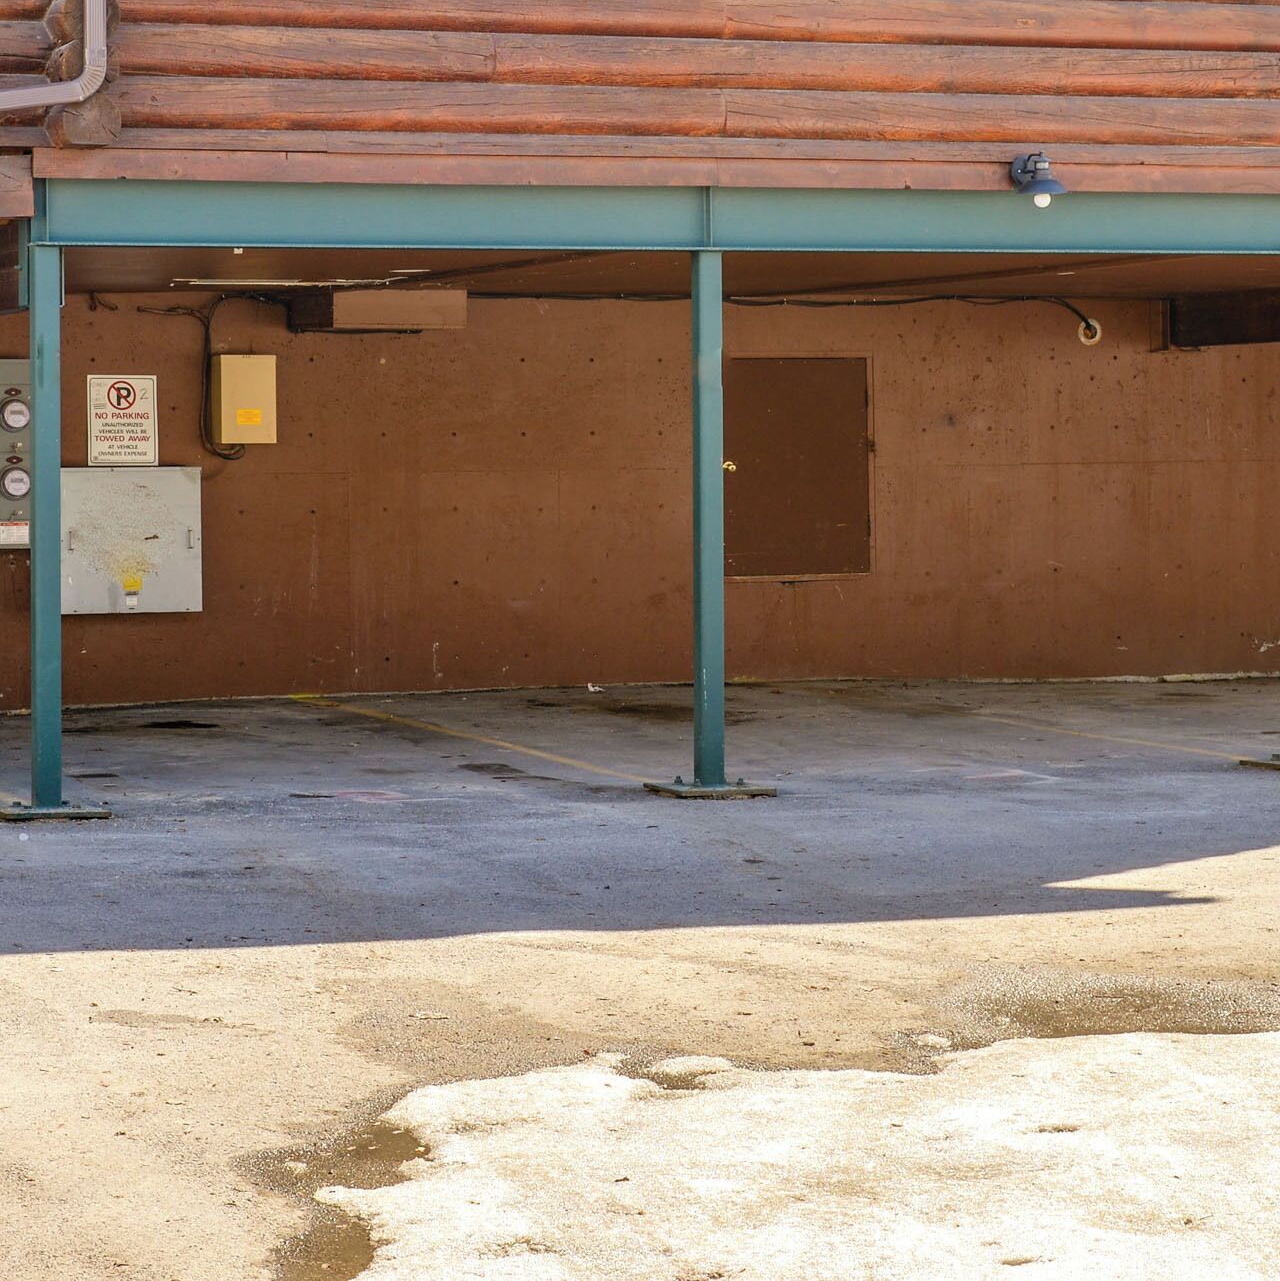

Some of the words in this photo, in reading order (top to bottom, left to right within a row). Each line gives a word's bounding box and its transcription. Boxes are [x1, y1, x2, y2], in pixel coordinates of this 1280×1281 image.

[139, 388, 149, 400] 2
[95, 412, 108, 420] NO
[111, 412, 150, 420] PARKING
